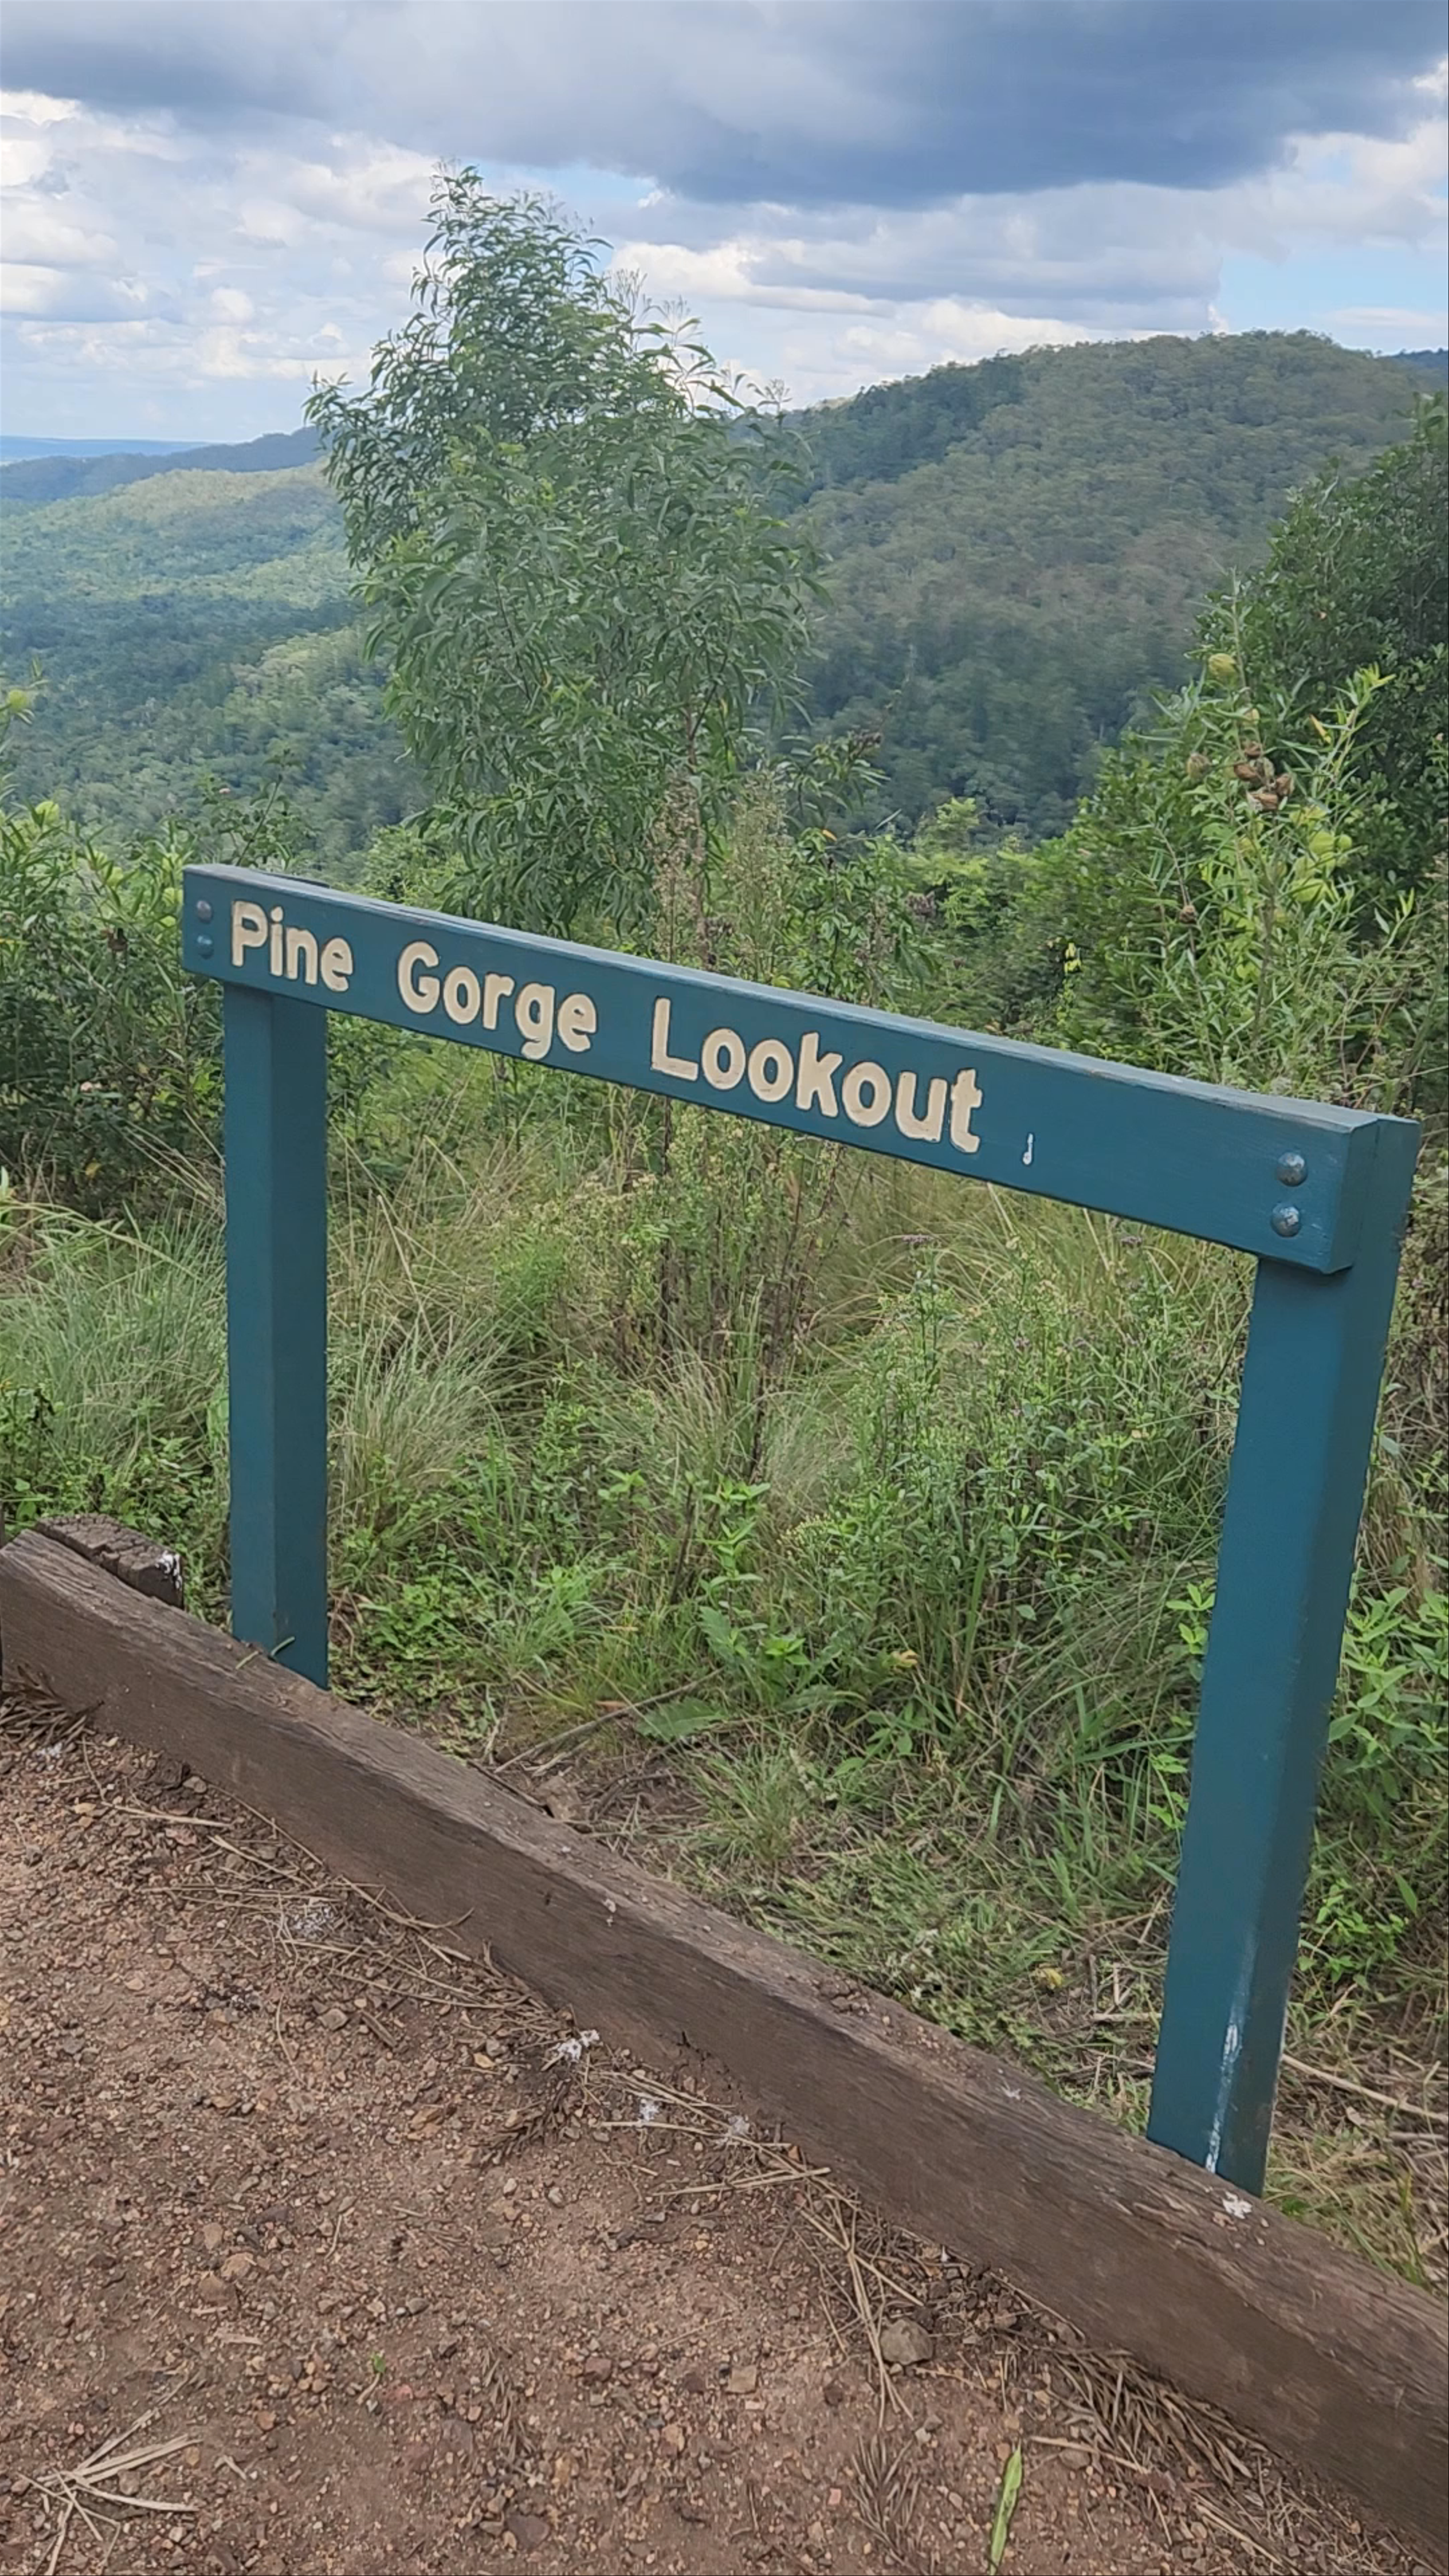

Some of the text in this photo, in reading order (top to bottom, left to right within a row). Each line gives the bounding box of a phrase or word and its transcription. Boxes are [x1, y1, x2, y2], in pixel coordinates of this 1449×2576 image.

[231, 901, 983, 1152] Pine Gorge Lookout
